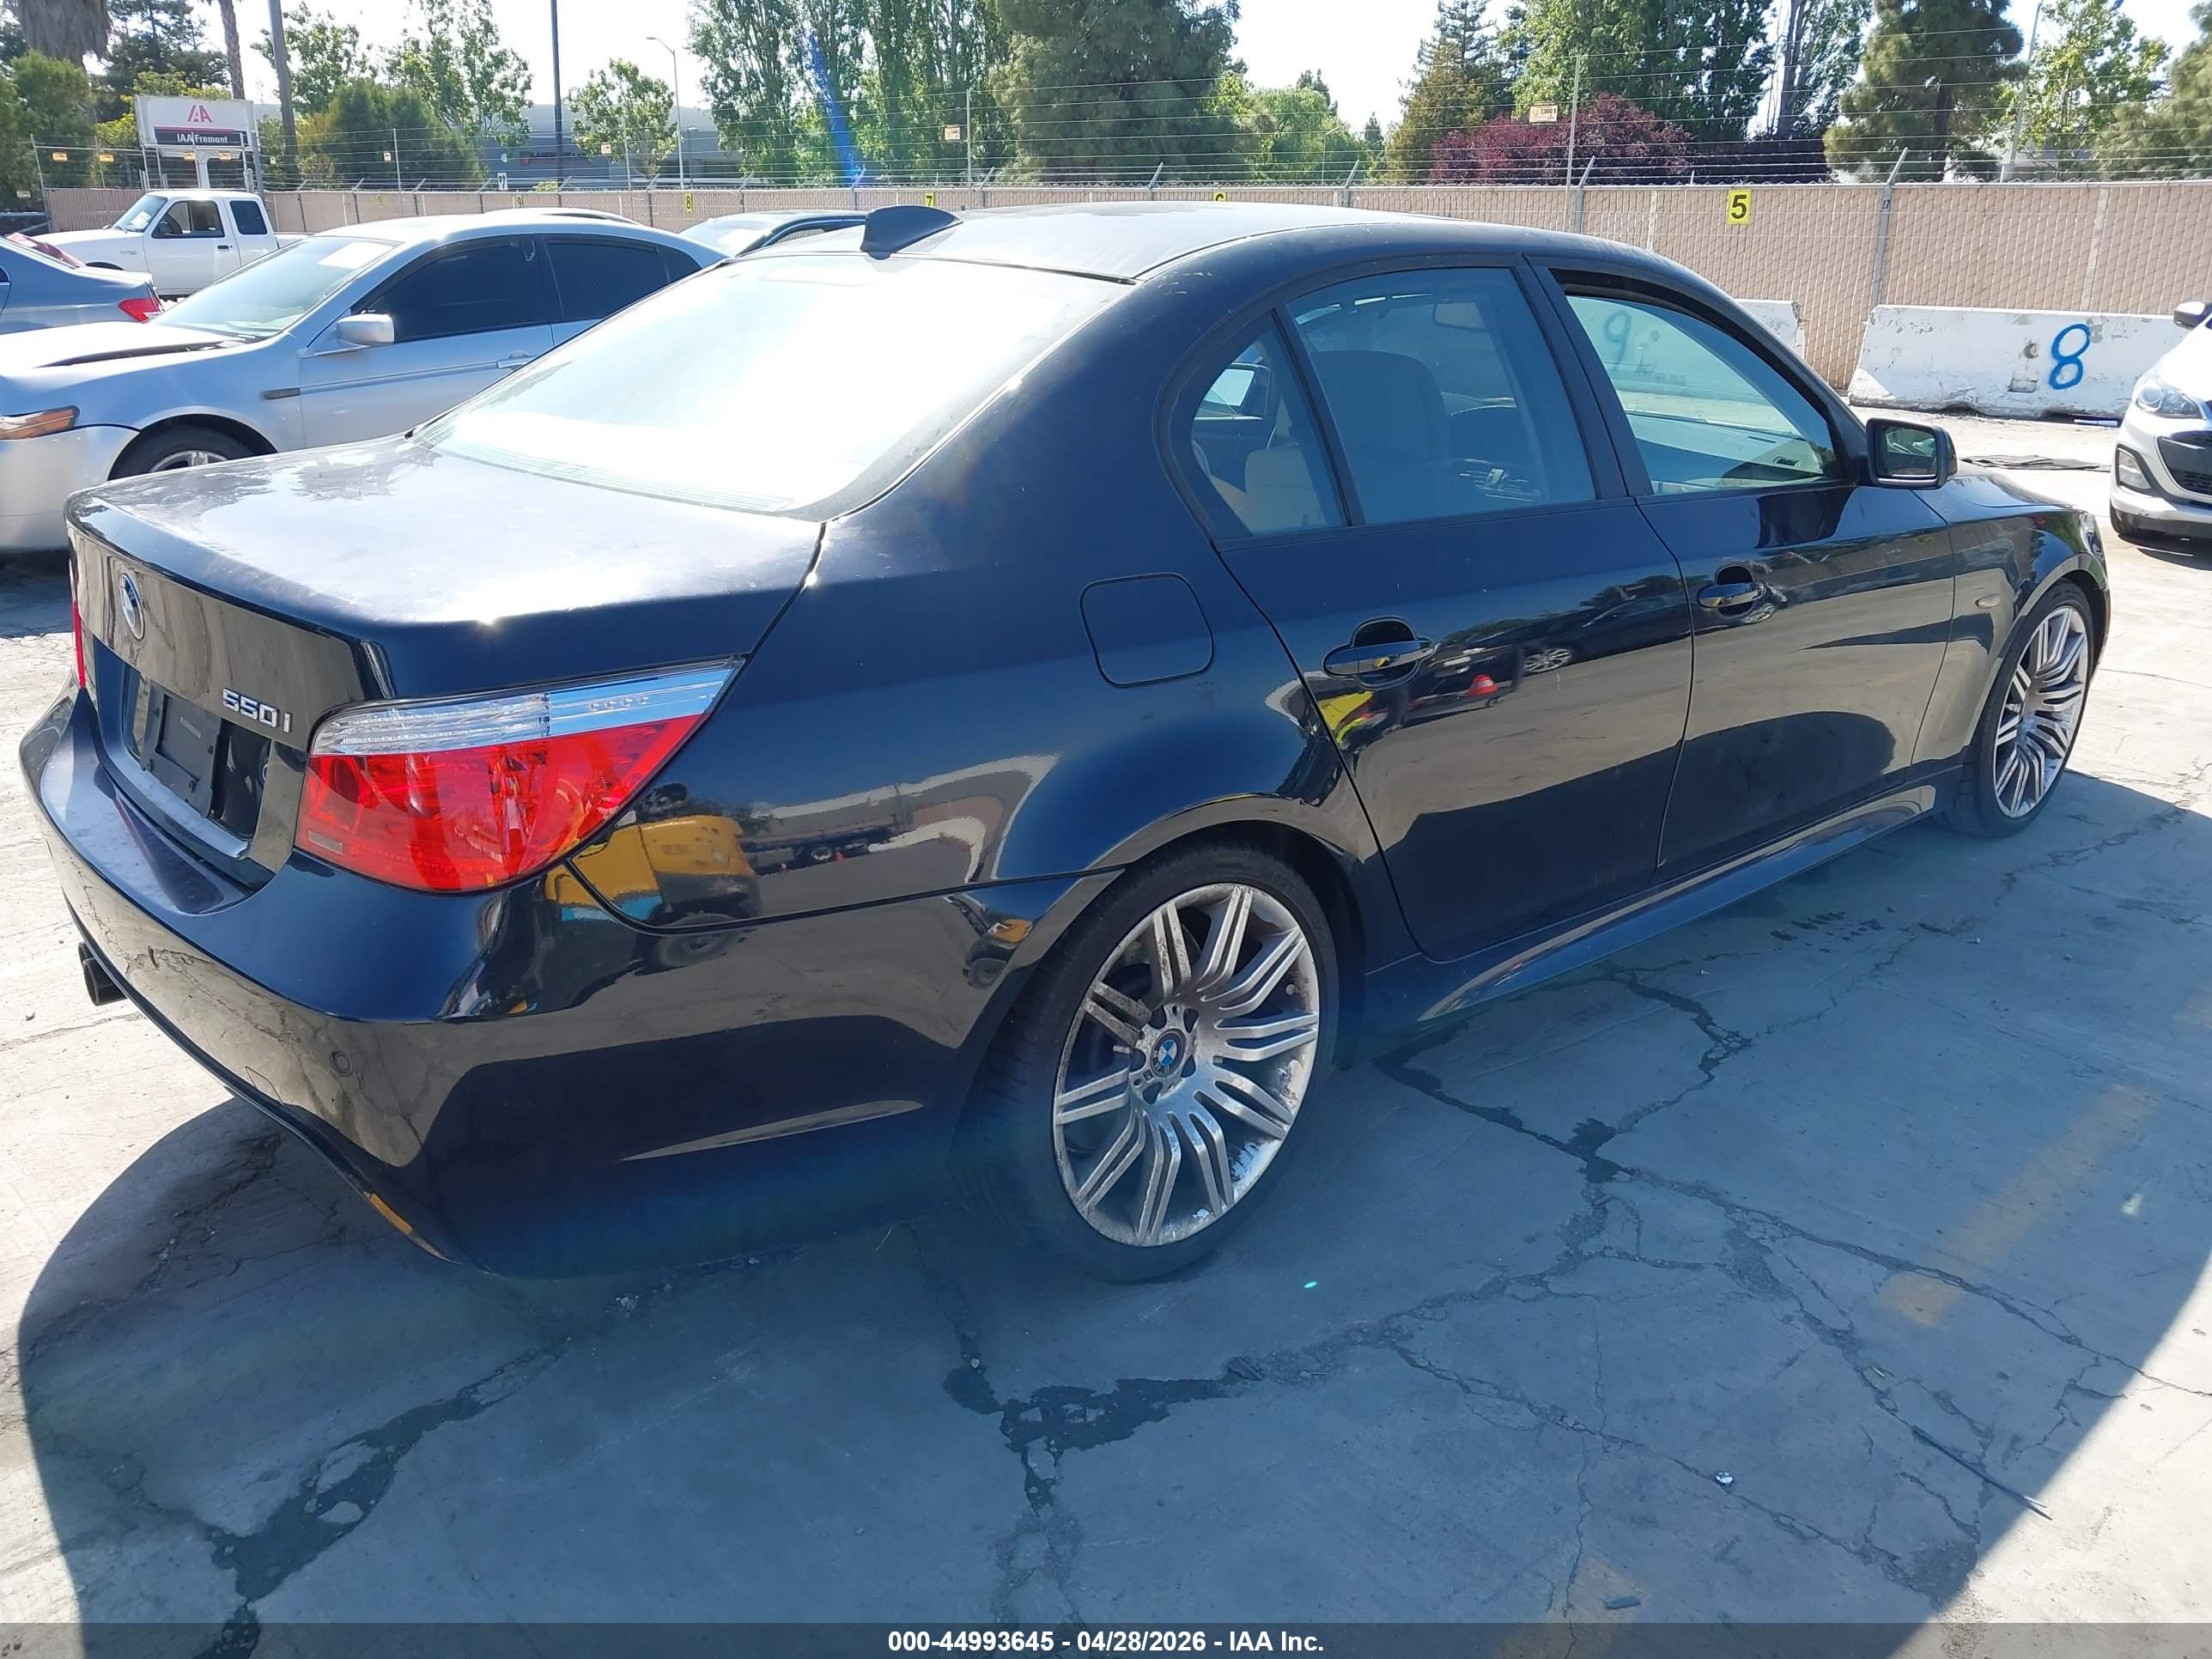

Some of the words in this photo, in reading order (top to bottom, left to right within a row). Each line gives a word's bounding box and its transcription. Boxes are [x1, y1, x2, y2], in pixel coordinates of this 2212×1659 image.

[177, 133, 192, 143] IAA
[195, 134, 228, 143] Fremont
[686, 196, 691, 210] 8
[926, 195, 933, 207] 7
[1730, 194, 1747, 219] 5
[2049, 323, 2090, 390] 8
